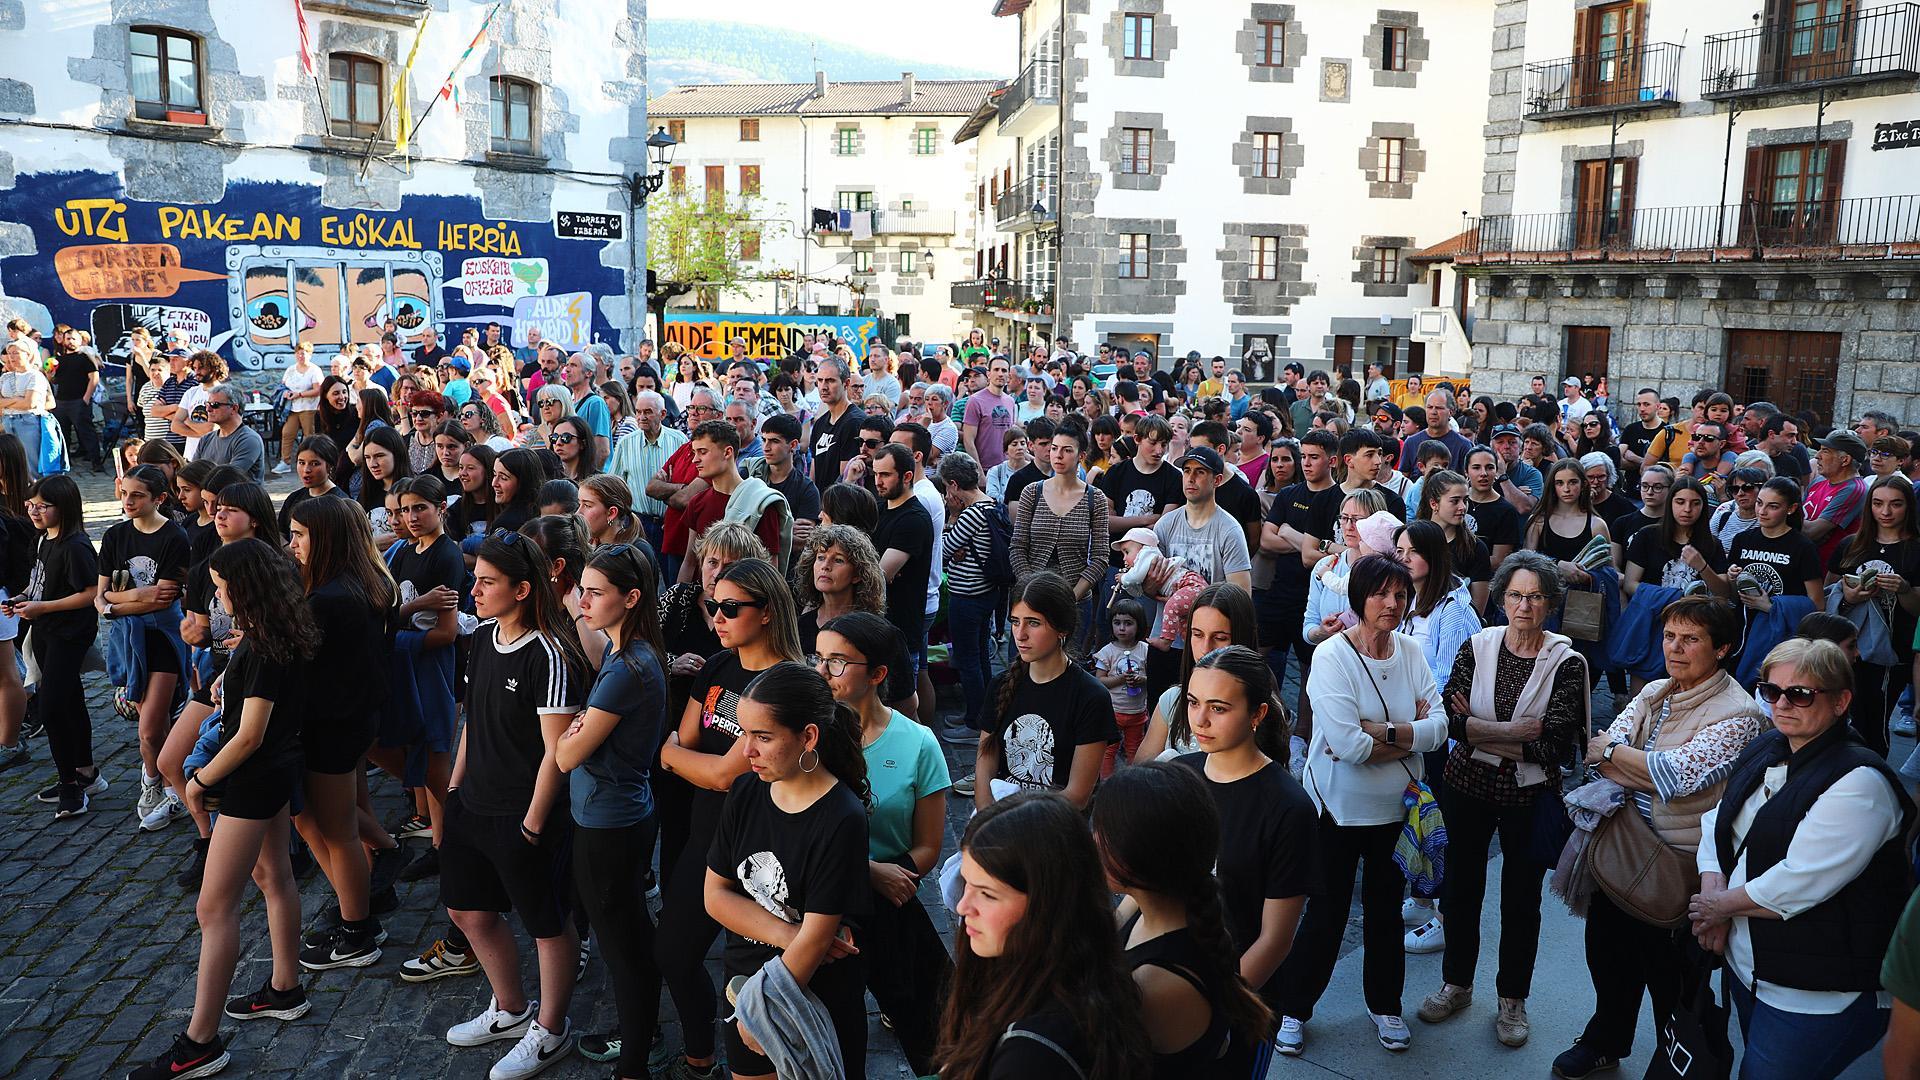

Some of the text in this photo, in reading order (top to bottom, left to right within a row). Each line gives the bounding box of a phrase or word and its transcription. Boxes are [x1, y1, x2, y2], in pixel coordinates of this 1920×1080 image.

[158, 206, 300, 241] PAKEAN
[321, 213, 422, 249] EUSKAL
[167, 310, 208, 323] ETXEN
[665, 325, 713, 355] ALDE
[1740, 549, 1790, 564] RAMONES
